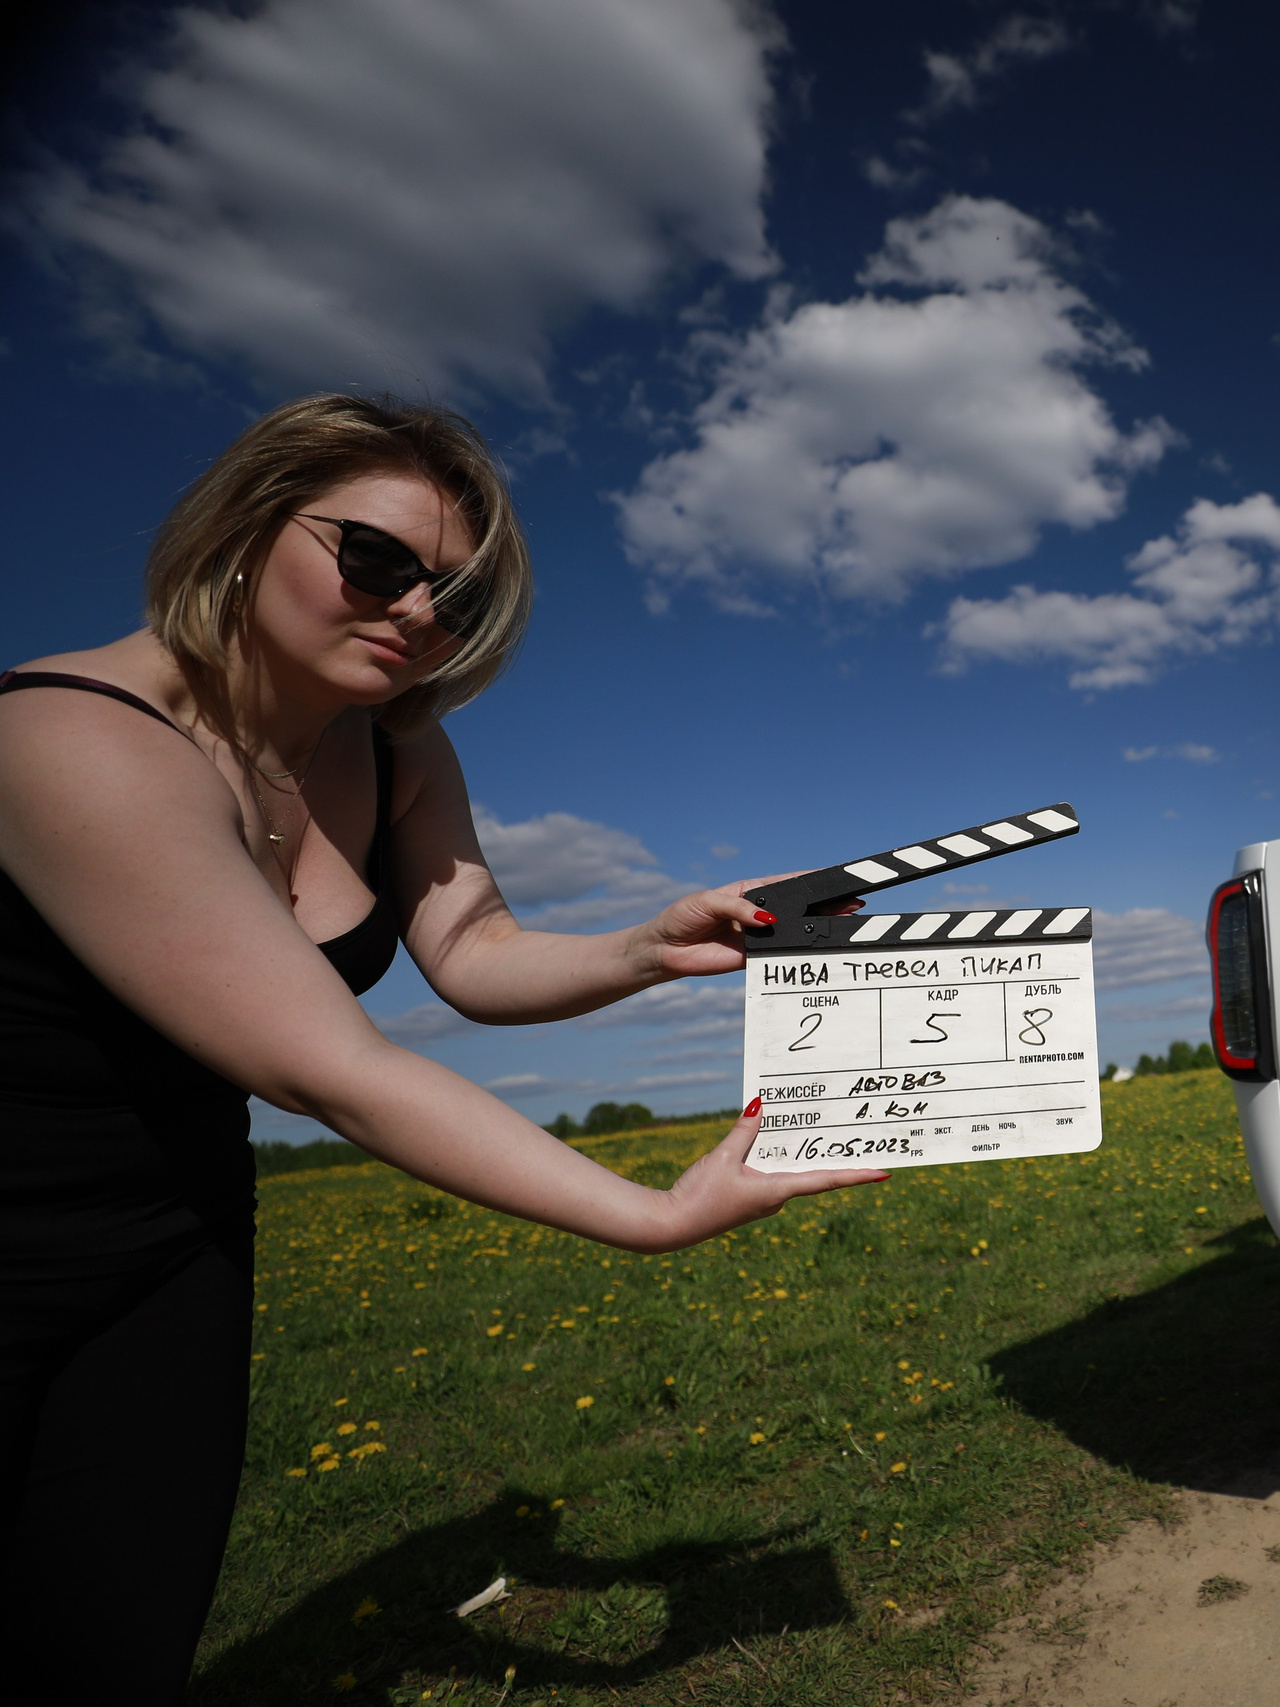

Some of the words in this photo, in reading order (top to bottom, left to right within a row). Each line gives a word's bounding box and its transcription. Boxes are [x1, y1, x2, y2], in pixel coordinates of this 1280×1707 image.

[764, 962, 829, 986] НИВА
[960, 953, 1042, 978] ПИКАП
[927, 989, 959, 1002] КАДР
[1024, 984, 1062, 997] ДУБЛЬ
[802, 995, 840, 1008] СЦЕНА
[788, 1013, 823, 1051] 2
[909, 1013, 961, 1044] 5
[1018, 1008, 1053, 1046] 8
[1019, 1052, 1085, 1064] RENTAPHOTO.COM
[759, 1082, 826, 1100] РЕЖИССЁР
[971, 1123, 990, 1133] ДЕНЬ
[998, 1121, 1017, 1130] НОЧЬ
[1055, 1117, 1074, 1126] ЗВУК
[910, 1128, 926, 1137] ИНТ.
[934, 1126, 954, 1135] ЭКСТ.
[795, 1137, 910, 1160] 16.05.2023
[910, 1149, 924, 1158] FPS
[971, 1142, 1001, 1152] ФИЛЬТР
